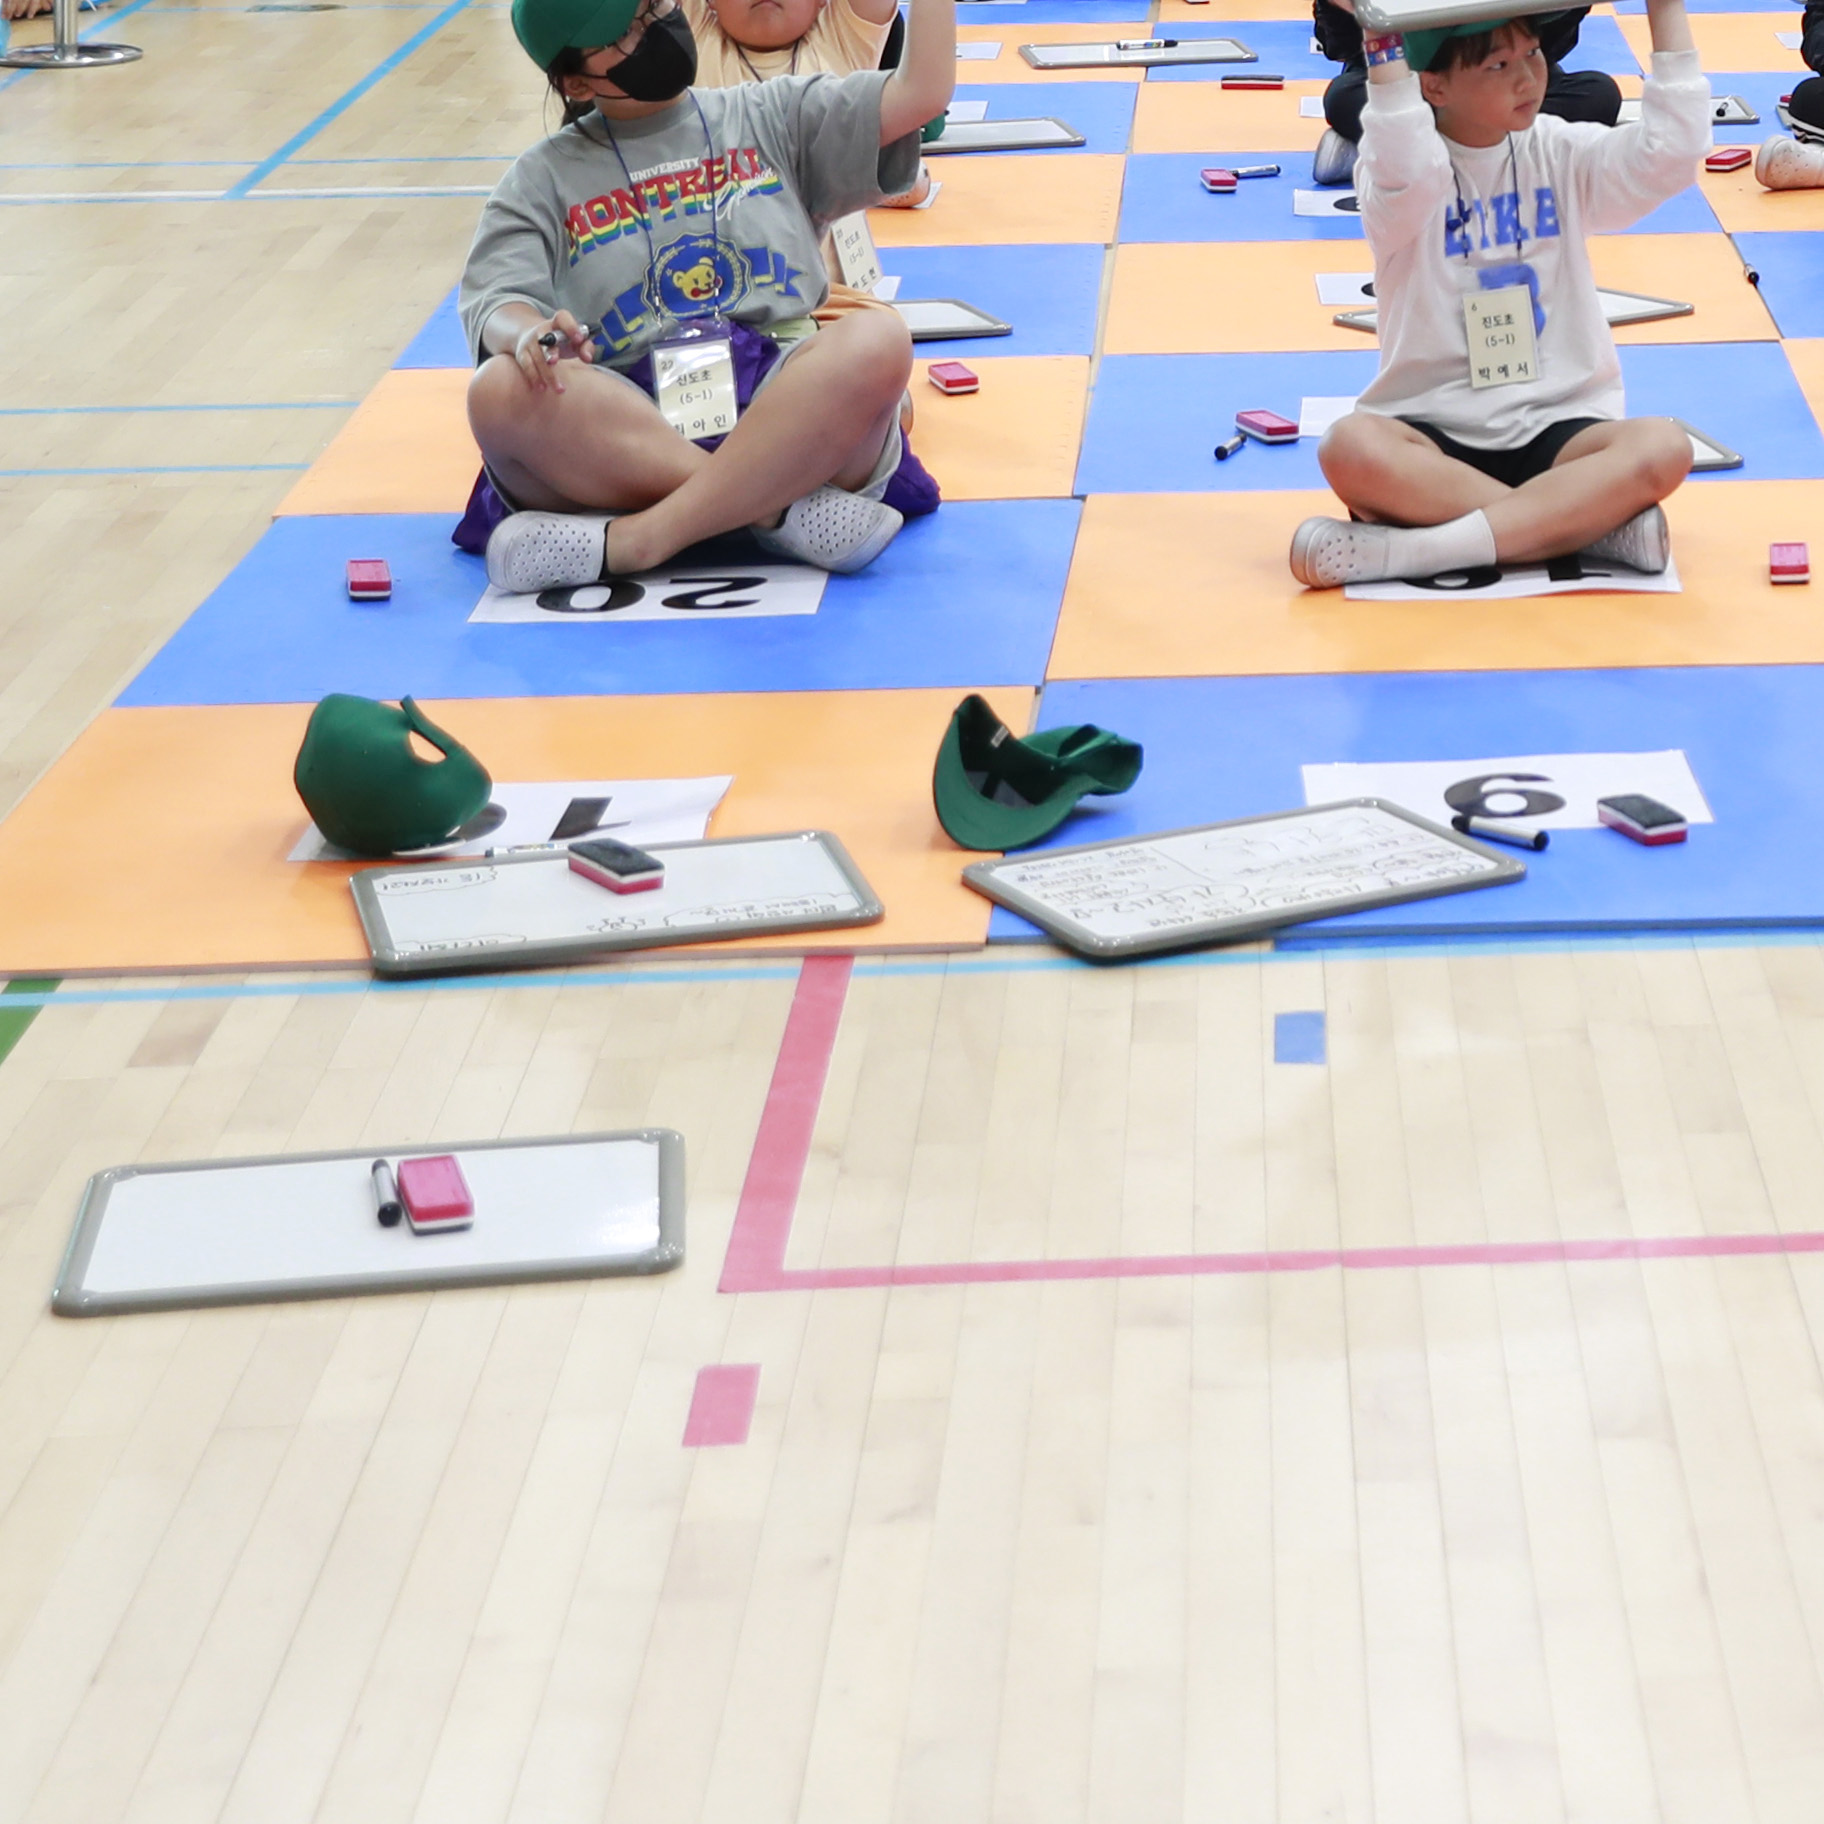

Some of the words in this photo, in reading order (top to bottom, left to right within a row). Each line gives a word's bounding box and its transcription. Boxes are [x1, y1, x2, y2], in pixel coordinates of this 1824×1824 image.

[629, 156, 701, 182] UNIVERSITY
[1482, 314, 1515, 330] 진도초
[1485, 335, 1516, 348] (5-1)
[1477, 361, 1530, 381] 박예서
[680, 389, 714, 407] (5-1)
